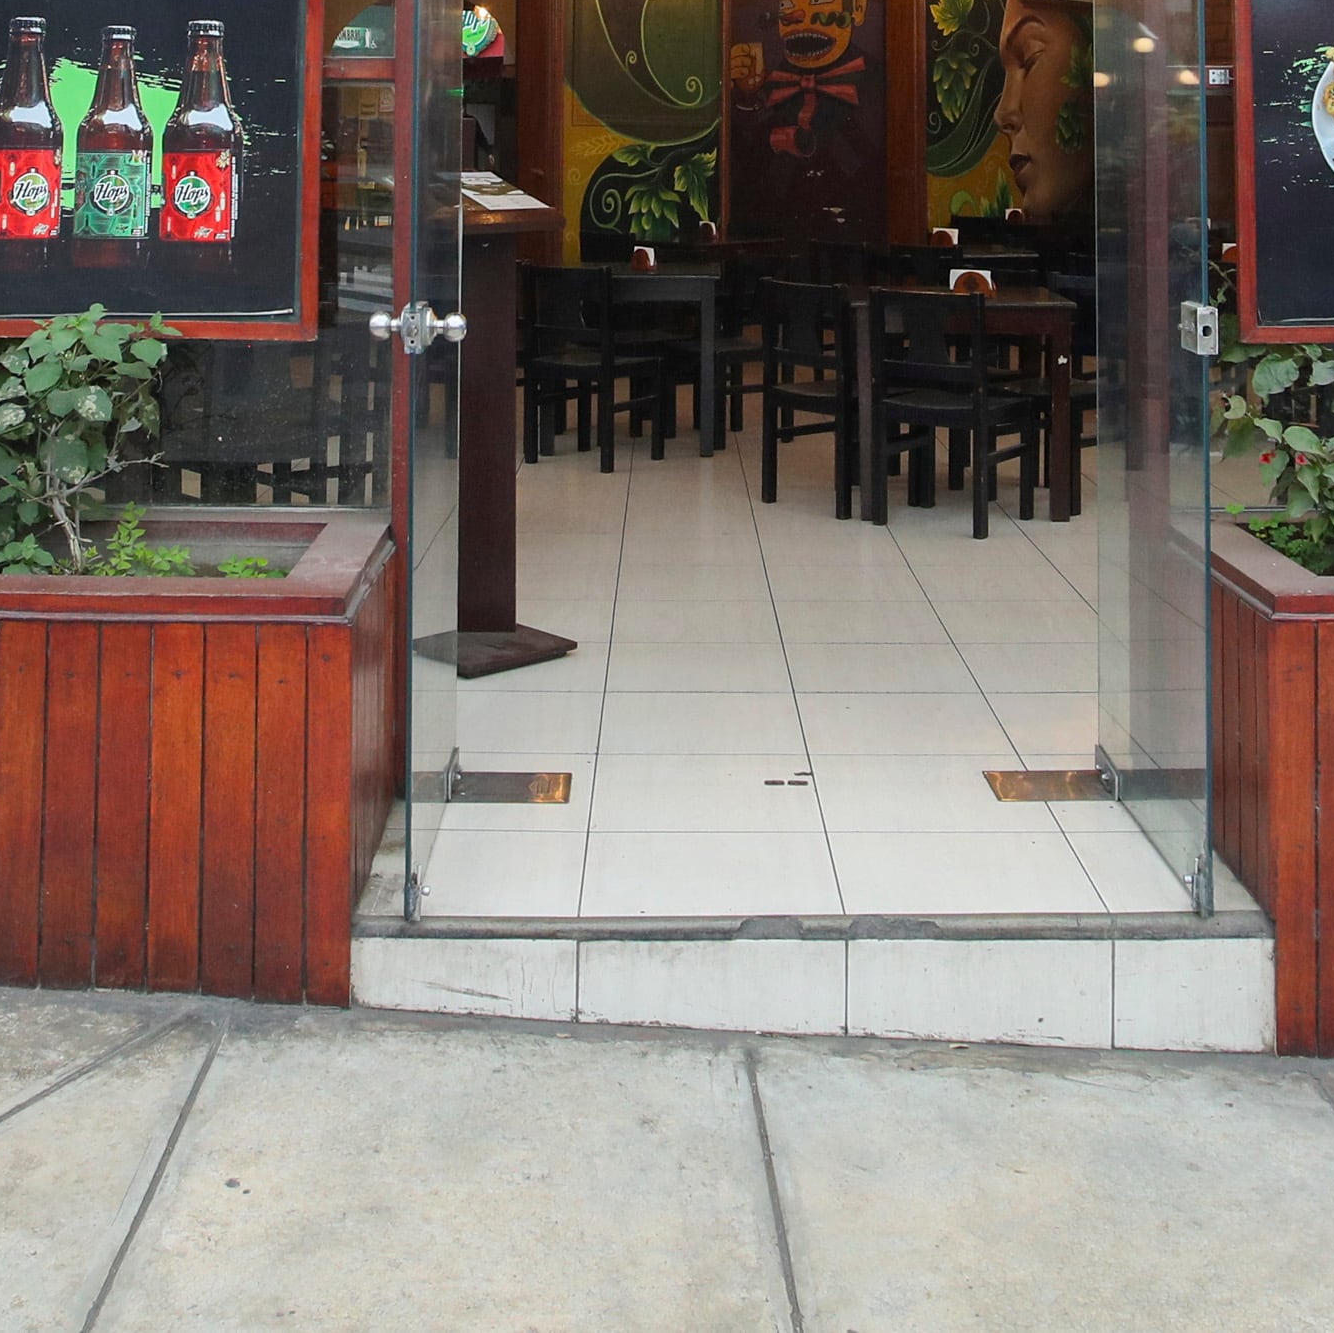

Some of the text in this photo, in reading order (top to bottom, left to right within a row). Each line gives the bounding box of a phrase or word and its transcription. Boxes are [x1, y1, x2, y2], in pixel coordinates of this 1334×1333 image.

[13, 180, 49, 203] Hops
[94, 181, 129, 203] Hops
[174, 182, 211, 205] Hops
